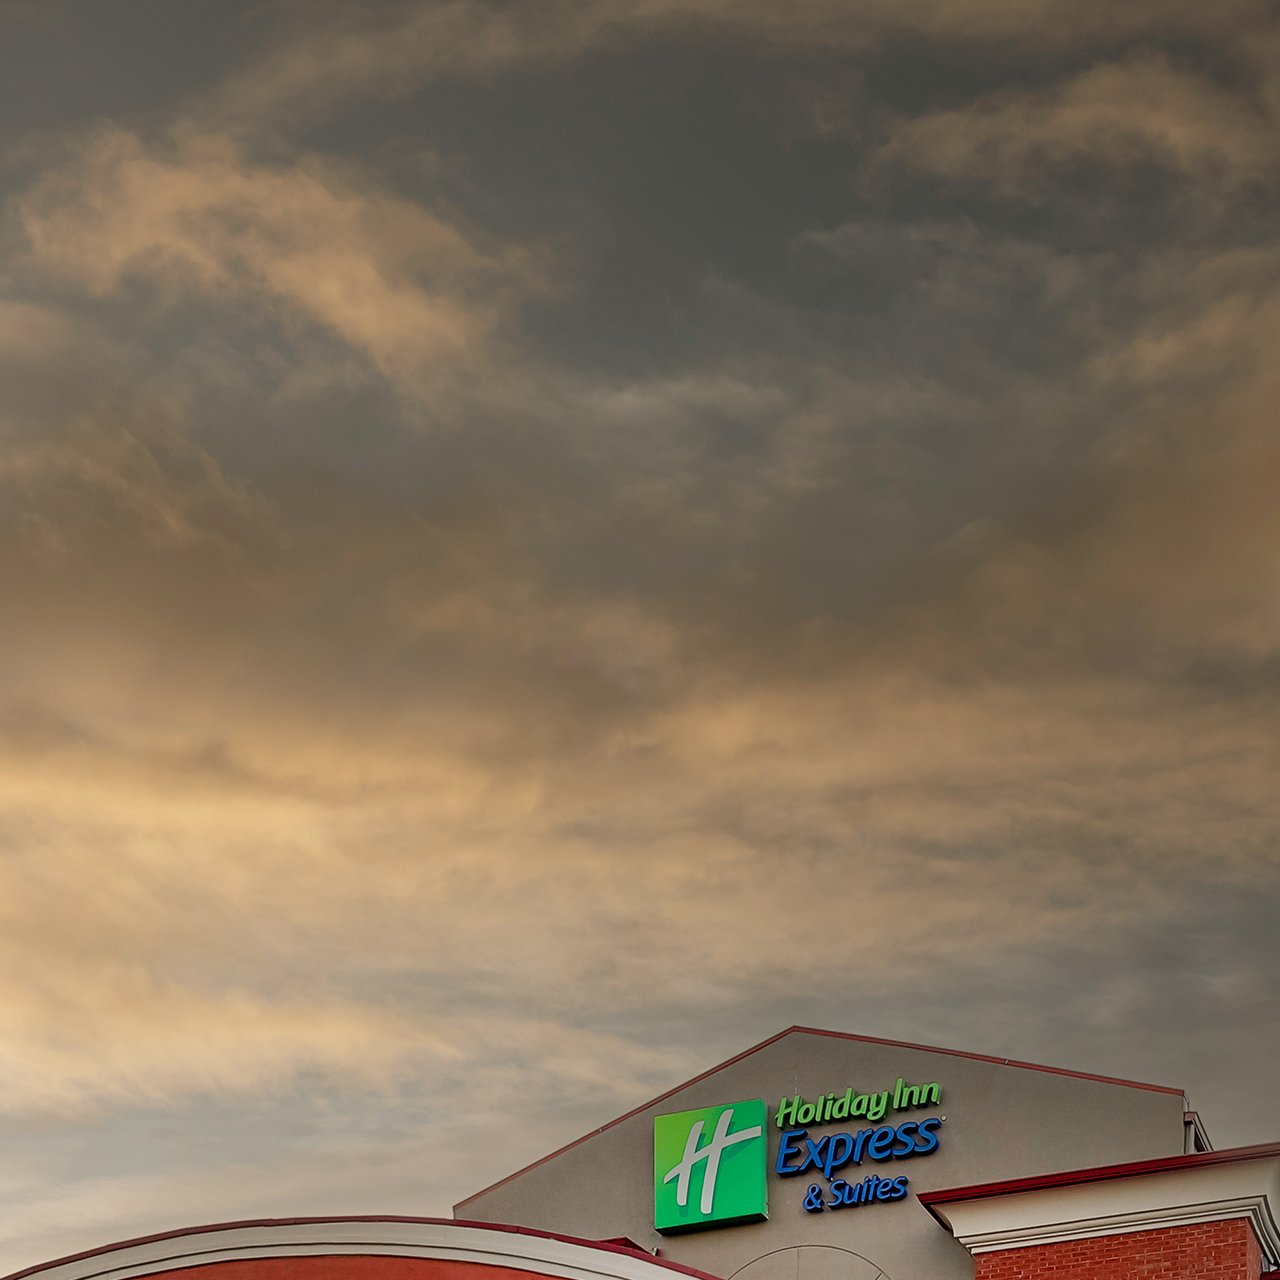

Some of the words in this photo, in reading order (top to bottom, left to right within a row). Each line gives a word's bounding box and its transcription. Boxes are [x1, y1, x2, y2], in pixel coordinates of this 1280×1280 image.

[775, 1087, 888, 1126] Holiday
[892, 1077, 941, 1109] Inn
[663, 1108, 762, 1215] H
[776, 1118, 941, 1179] Express
[802, 1183, 824, 1212] &
[827, 1174, 910, 1209] Suites
